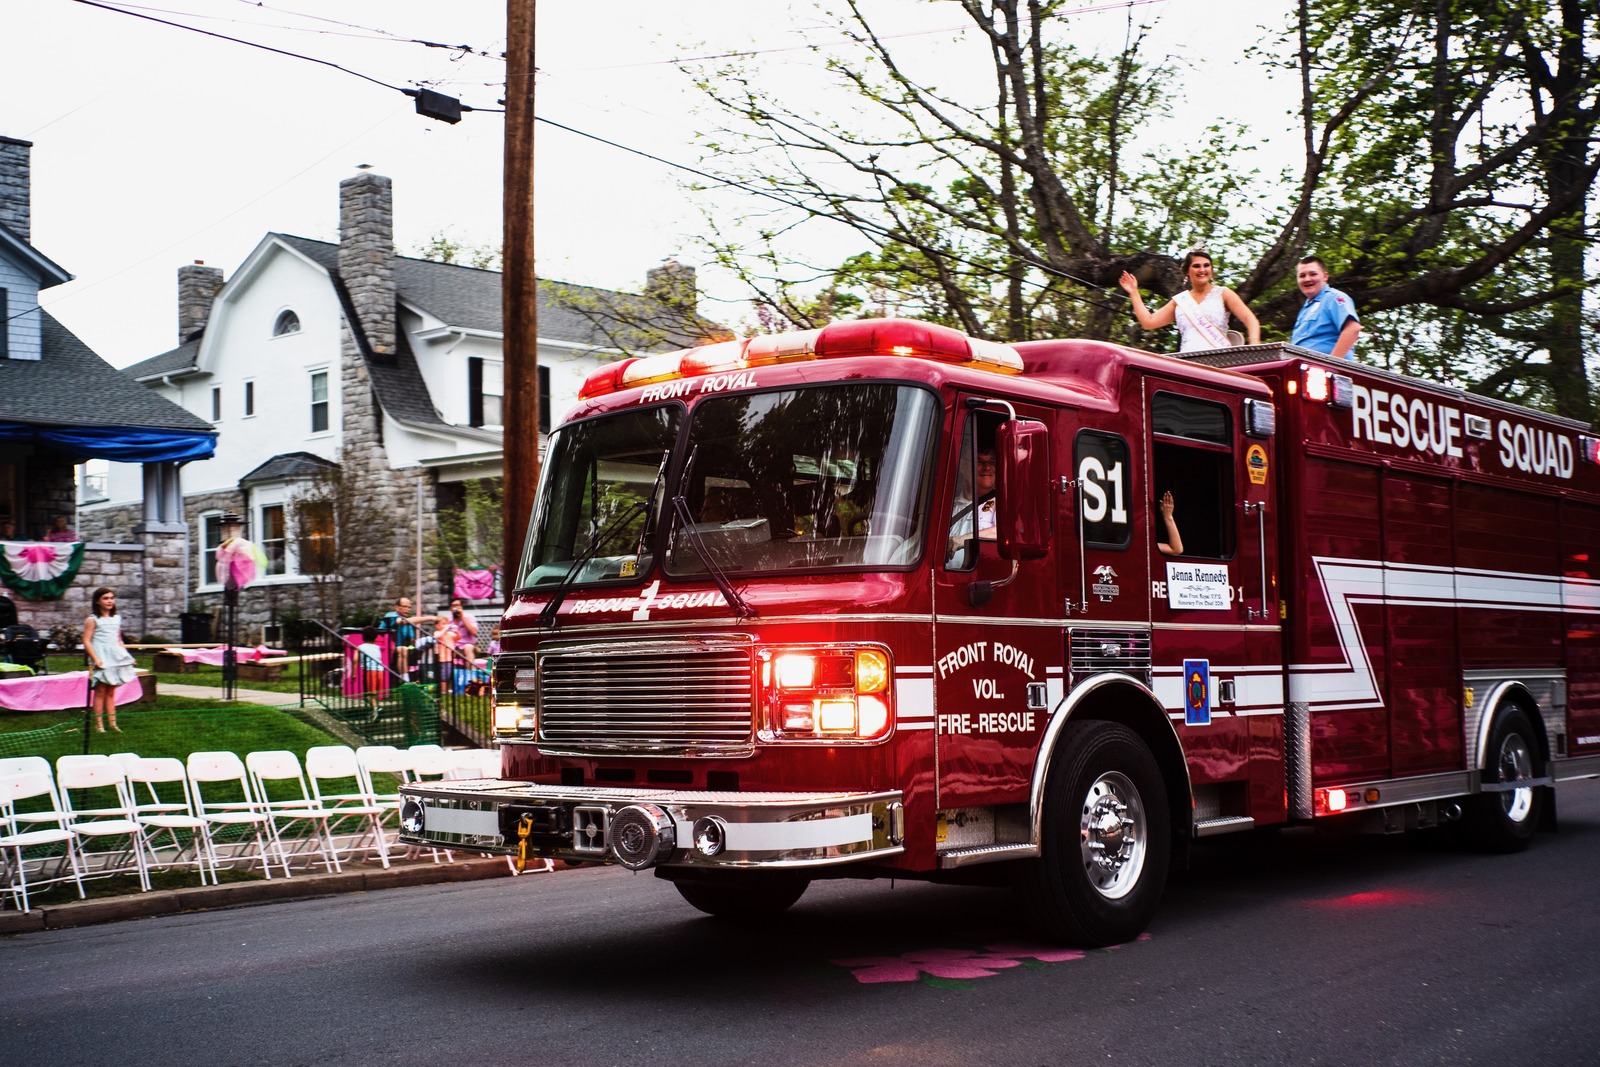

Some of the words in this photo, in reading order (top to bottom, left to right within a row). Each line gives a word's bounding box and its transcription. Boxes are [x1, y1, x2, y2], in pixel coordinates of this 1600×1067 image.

[639, 379, 697, 404] FRONT
[700, 371, 758, 393] ROYAL
[1352, 384, 1463, 458] RESCUE
[1498, 419, 1574, 479] SQUAD
[1079, 456, 1127, 524] S1
[1171, 567, 1193, 581] Jenna
[1194, 568, 1227, 586] Kennedy
[569, 597, 640, 614] RESCUE
[632, 580, 660, 621] 1
[1237, 586, 1244, 603] 1
[937, 641, 987, 680] FRONT
[993, 642, 1036, 680] ROYAL
[972, 679, 1005, 699] VOL.
[938, 712, 1036, 735] FIRE-RESCUE
